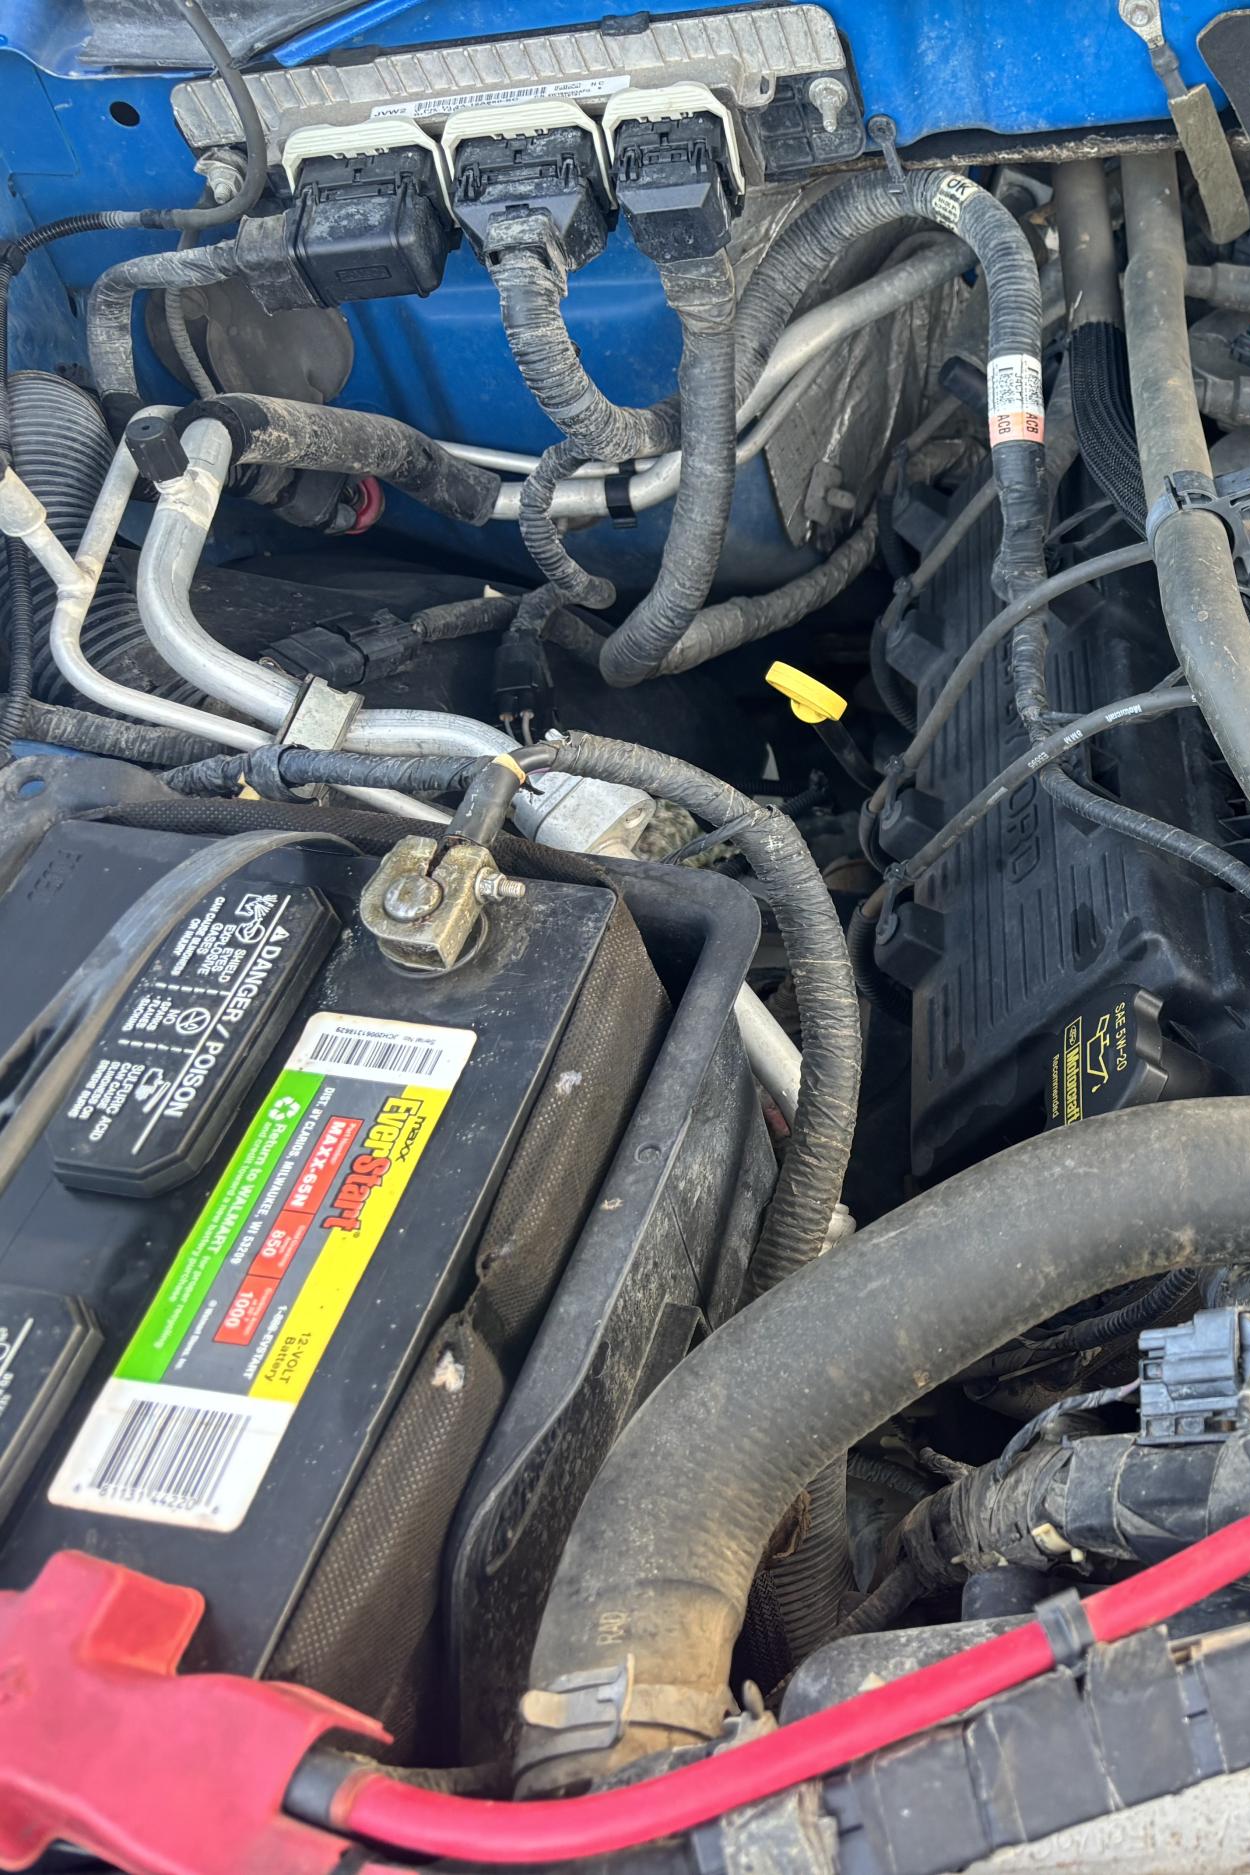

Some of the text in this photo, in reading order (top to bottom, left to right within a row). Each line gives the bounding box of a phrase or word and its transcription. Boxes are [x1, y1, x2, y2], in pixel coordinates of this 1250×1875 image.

[947, 178, 974, 196] OK
[997, 414, 1011, 435] ACB
[1026, 412, 1039, 434] ACB
[194, 912, 216, 936] CAUSE
[209, 896, 226, 911] CAN
[170, 918, 201, 955] OR INJURY
[195, 922, 224, 955] GASES
[196, 924, 237, 975] EXPLOSIVE
[210, 947, 234, 972] EYES
[216, 948, 247, 983] SHIELD
[221, 944, 282, 1022] DANGER
[161, 1008, 180, 1025] NO
[1115, 1002, 1128, 1071] SAE 5W-20
[95, 1061, 132, 1109] CAN CAUSE
[162, 1040, 224, 1120] POISON
[1052, 1054, 1060, 1119] Recommended
[1067, 1047, 1080, 1125] Motorcraft
[87, 1063, 145, 1142] SULFURIC ACID
[253, 1123, 288, 1165] Return
[394, 1115, 427, 1163] maxx
[228, 1086, 336, 1265] DIST. BY CLARIOS, MILWAUKEE, WI 53209
[244, 1167, 263, 1182] to
[288, 1119, 346, 1207] MAXX-65N
[319, 1095, 424, 1233] EverStart
[204, 1183, 255, 1254] WALMART
[259, 1229, 287, 1257] 850
[222, 1289, 255, 1328] 1000
[263, 1336, 296, 1382] Battery
[277, 1331, 312, 1384] 12-VOLT
[596, 1611, 628, 1647] RAD
